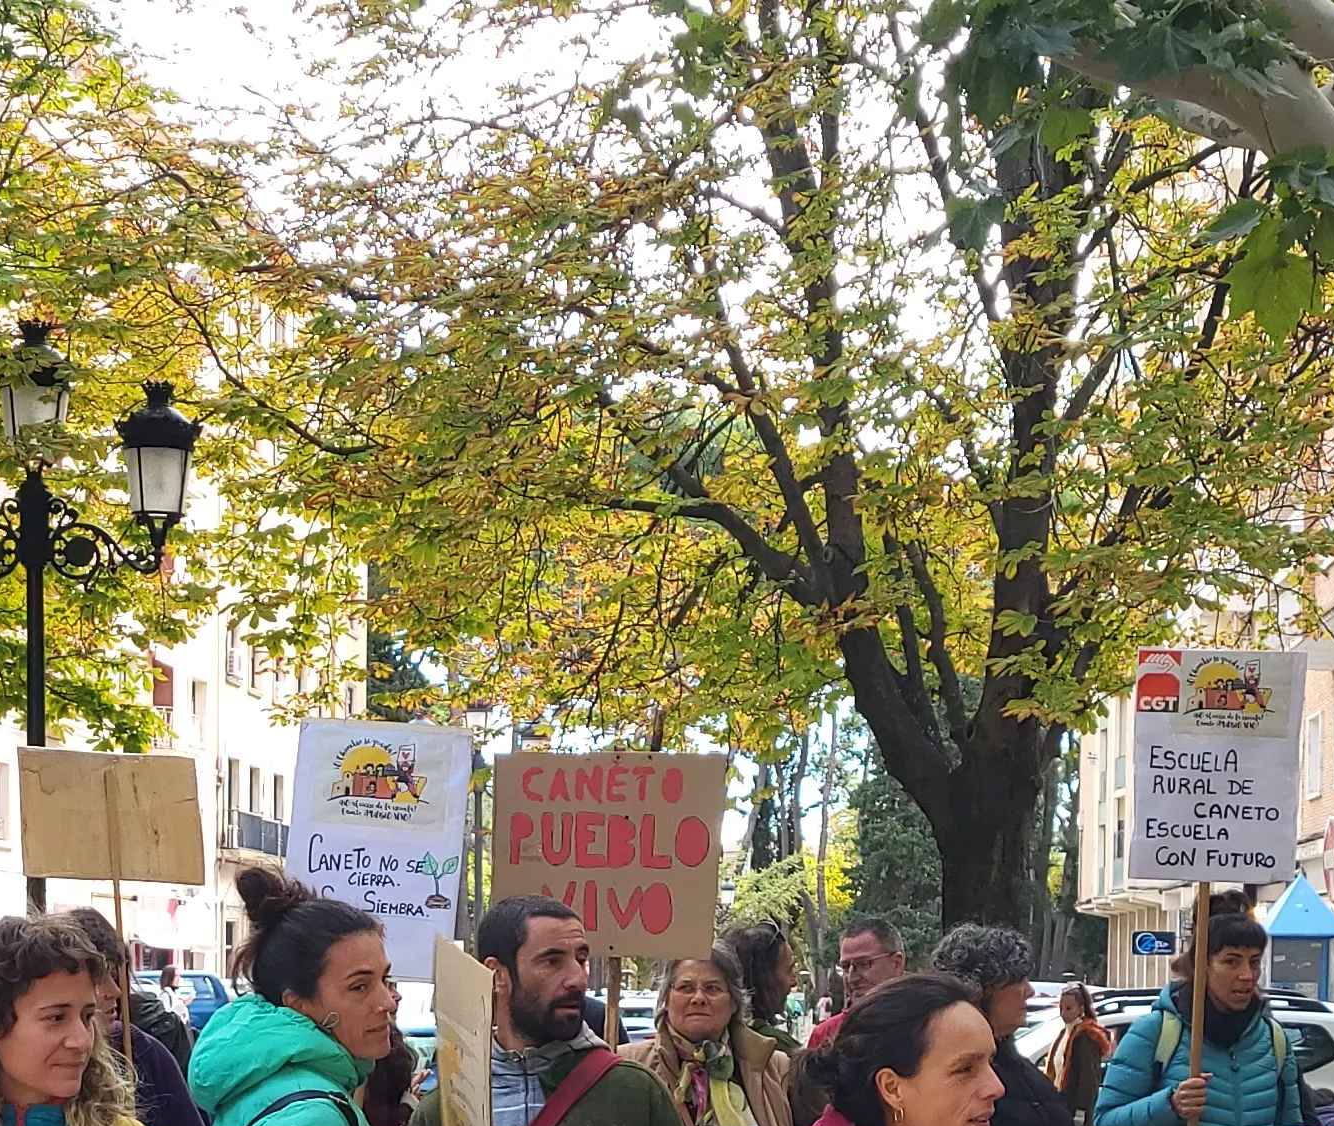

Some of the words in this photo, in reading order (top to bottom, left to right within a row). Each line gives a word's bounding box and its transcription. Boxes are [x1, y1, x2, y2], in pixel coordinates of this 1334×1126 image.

[1139, 696, 1178, 711] CGT
[1150, 745, 1238, 773] ESCUELA
[1153, 774, 1217, 795] RURAL
[1227, 779, 1254, 795] DE
[1193, 802, 1280, 821] CANETO
[509, 811, 710, 869] PUEBLO
[1146, 818, 1230, 840] ESCUELA
[308, 833, 372, 873] CANETO
[379, 854, 399, 872] NO
[406, 859, 426, 874] SE
[1155, 846, 1196, 867] CON
[1206, 849, 1276, 869] FUTURO
